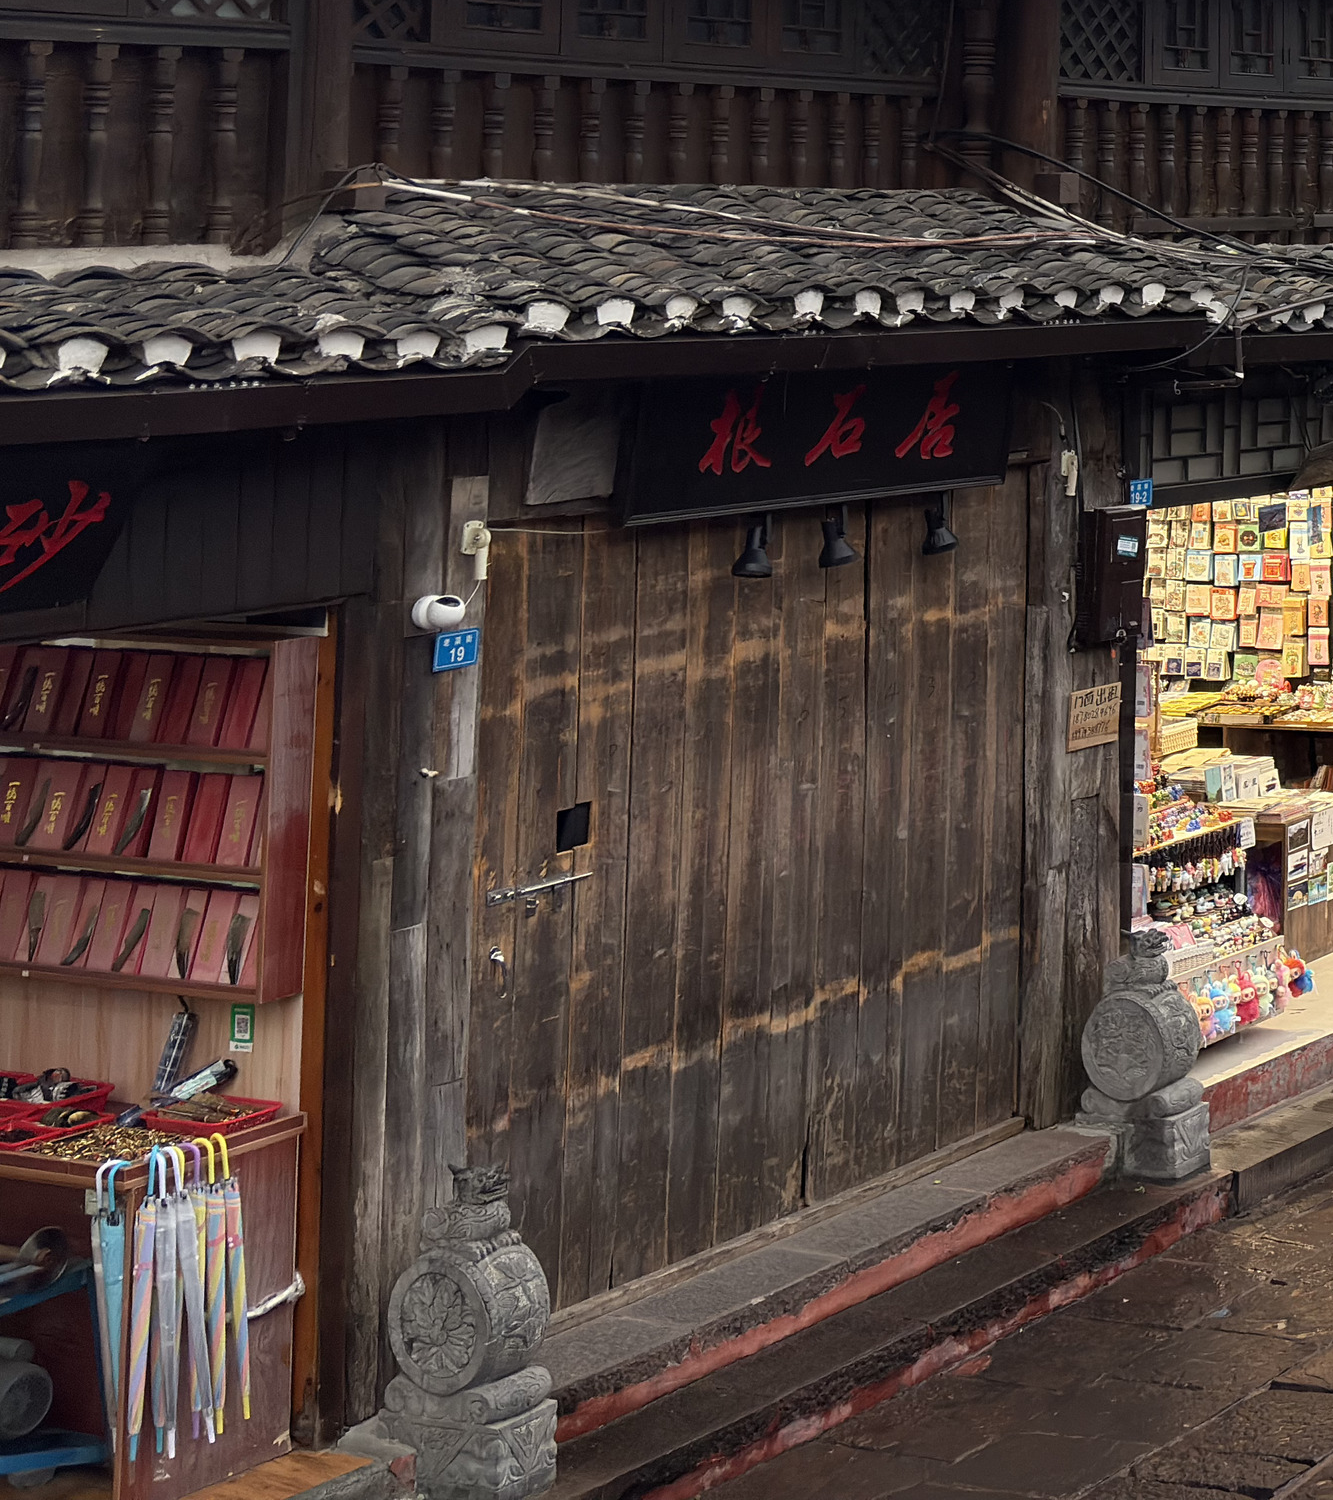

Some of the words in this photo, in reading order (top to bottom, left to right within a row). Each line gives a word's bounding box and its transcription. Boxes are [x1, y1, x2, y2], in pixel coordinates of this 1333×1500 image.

[698, 370, 960, 476] 根石居
[1131, 491, 1148, 504] 19-2
[449, 646, 465, 662] 19
